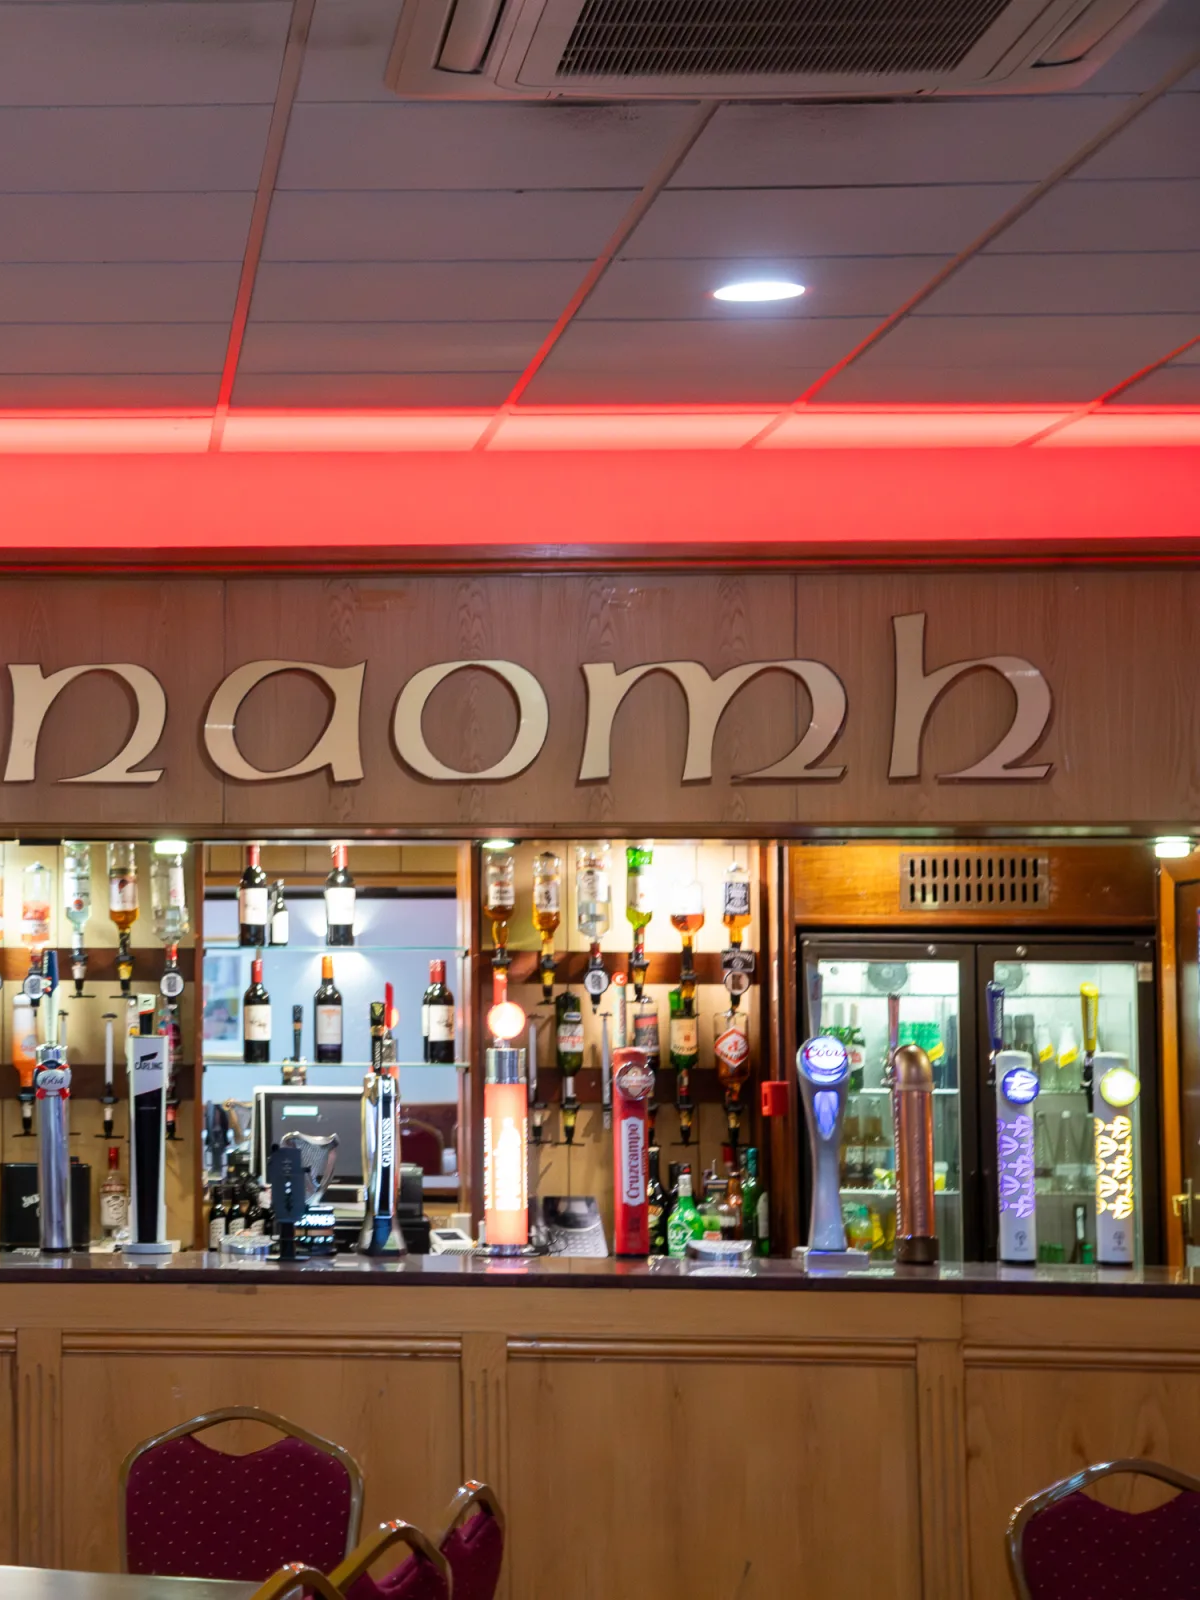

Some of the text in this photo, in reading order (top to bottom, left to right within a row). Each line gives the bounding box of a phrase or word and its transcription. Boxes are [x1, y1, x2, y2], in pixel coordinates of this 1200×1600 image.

[3, 611, 1054, 784] naomh
[382, 1117, 392, 1167] GUINNESS
[626, 1123, 641, 1199] Cruzcampo
